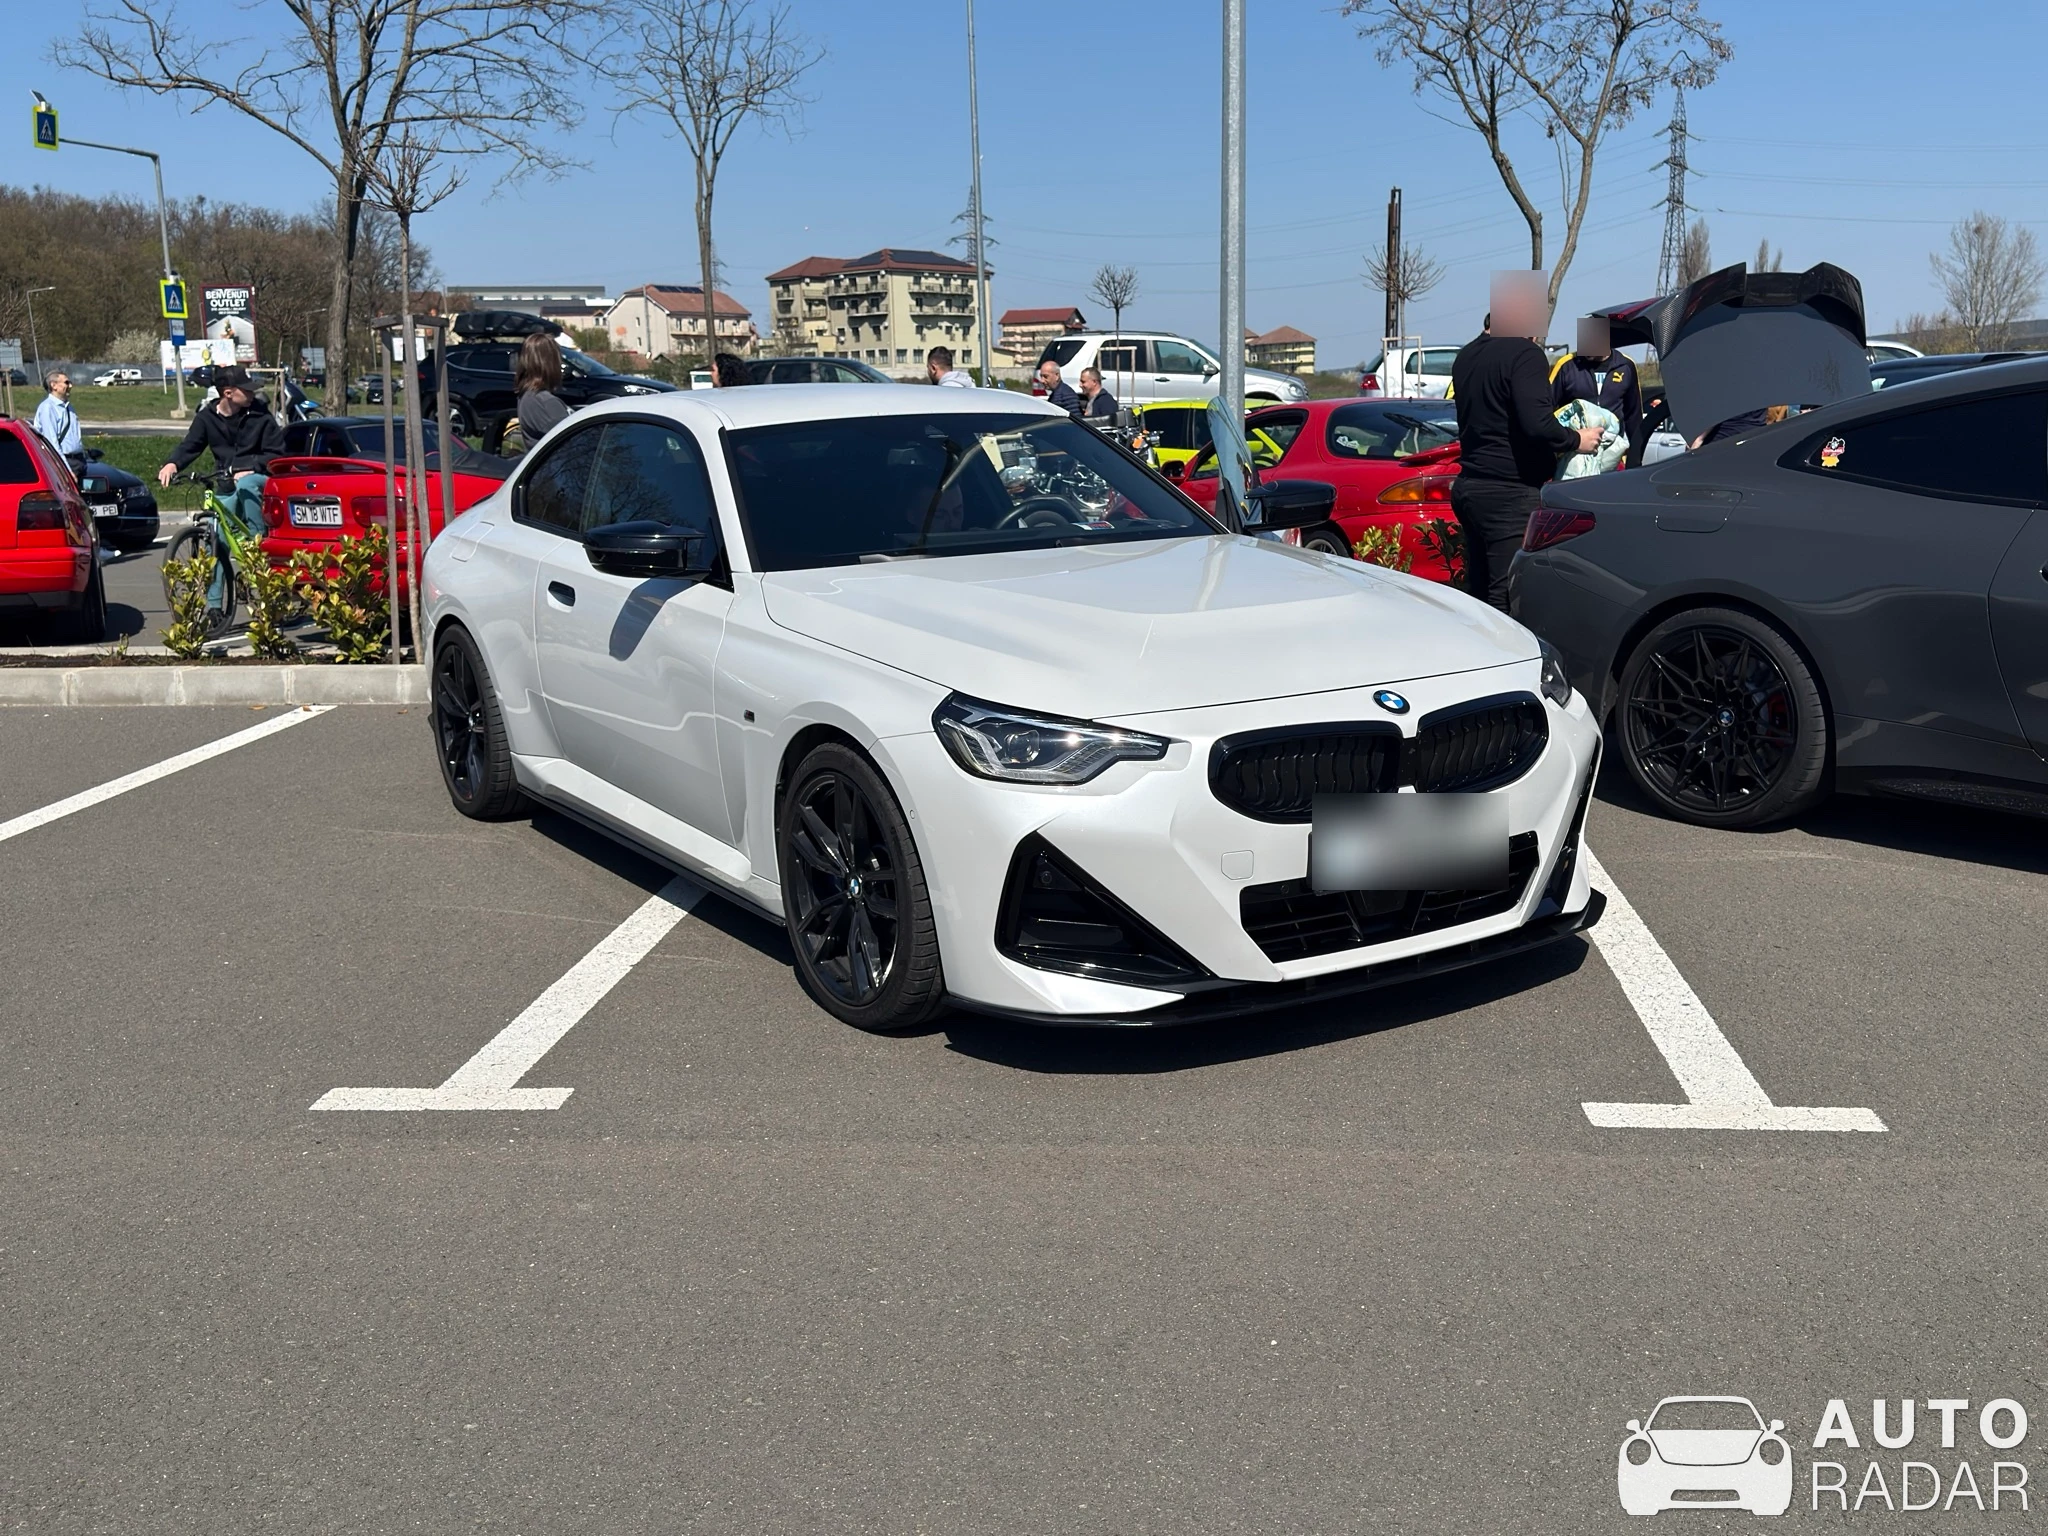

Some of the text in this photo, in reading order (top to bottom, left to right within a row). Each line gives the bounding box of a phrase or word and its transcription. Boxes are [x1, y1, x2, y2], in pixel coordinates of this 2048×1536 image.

[210, 299, 246, 308] OUTLET
[296, 507, 339, 523] SM 18 WTF
